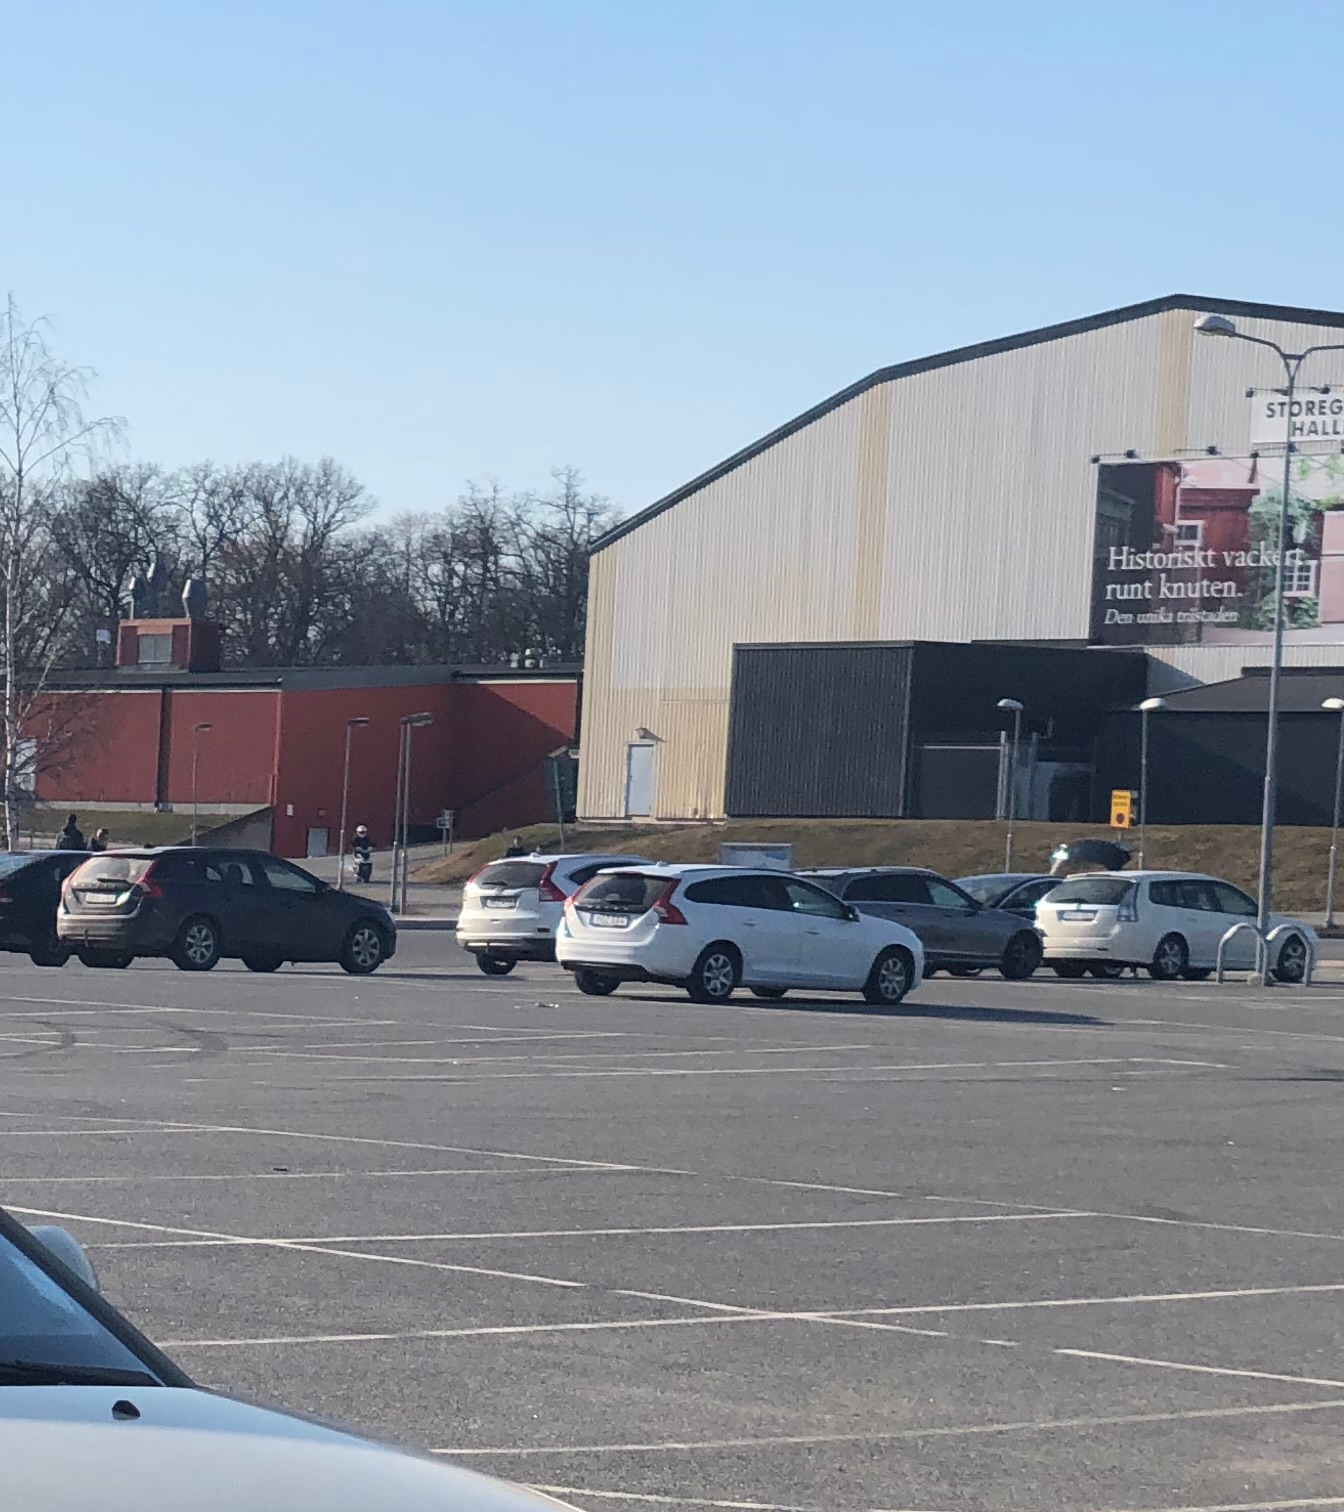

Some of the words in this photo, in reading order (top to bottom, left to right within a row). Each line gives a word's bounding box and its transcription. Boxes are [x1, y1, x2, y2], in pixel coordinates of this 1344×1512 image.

[1292, 420, 1344, 437] HALL
[1107, 546, 1216, 570] Historiskt
[1222, 541, 1305, 567] vackert
[1105, 581, 1152, 599] runt
[1159, 573, 1243, 598] knuten.
[1104, 608, 1133, 624] Den
